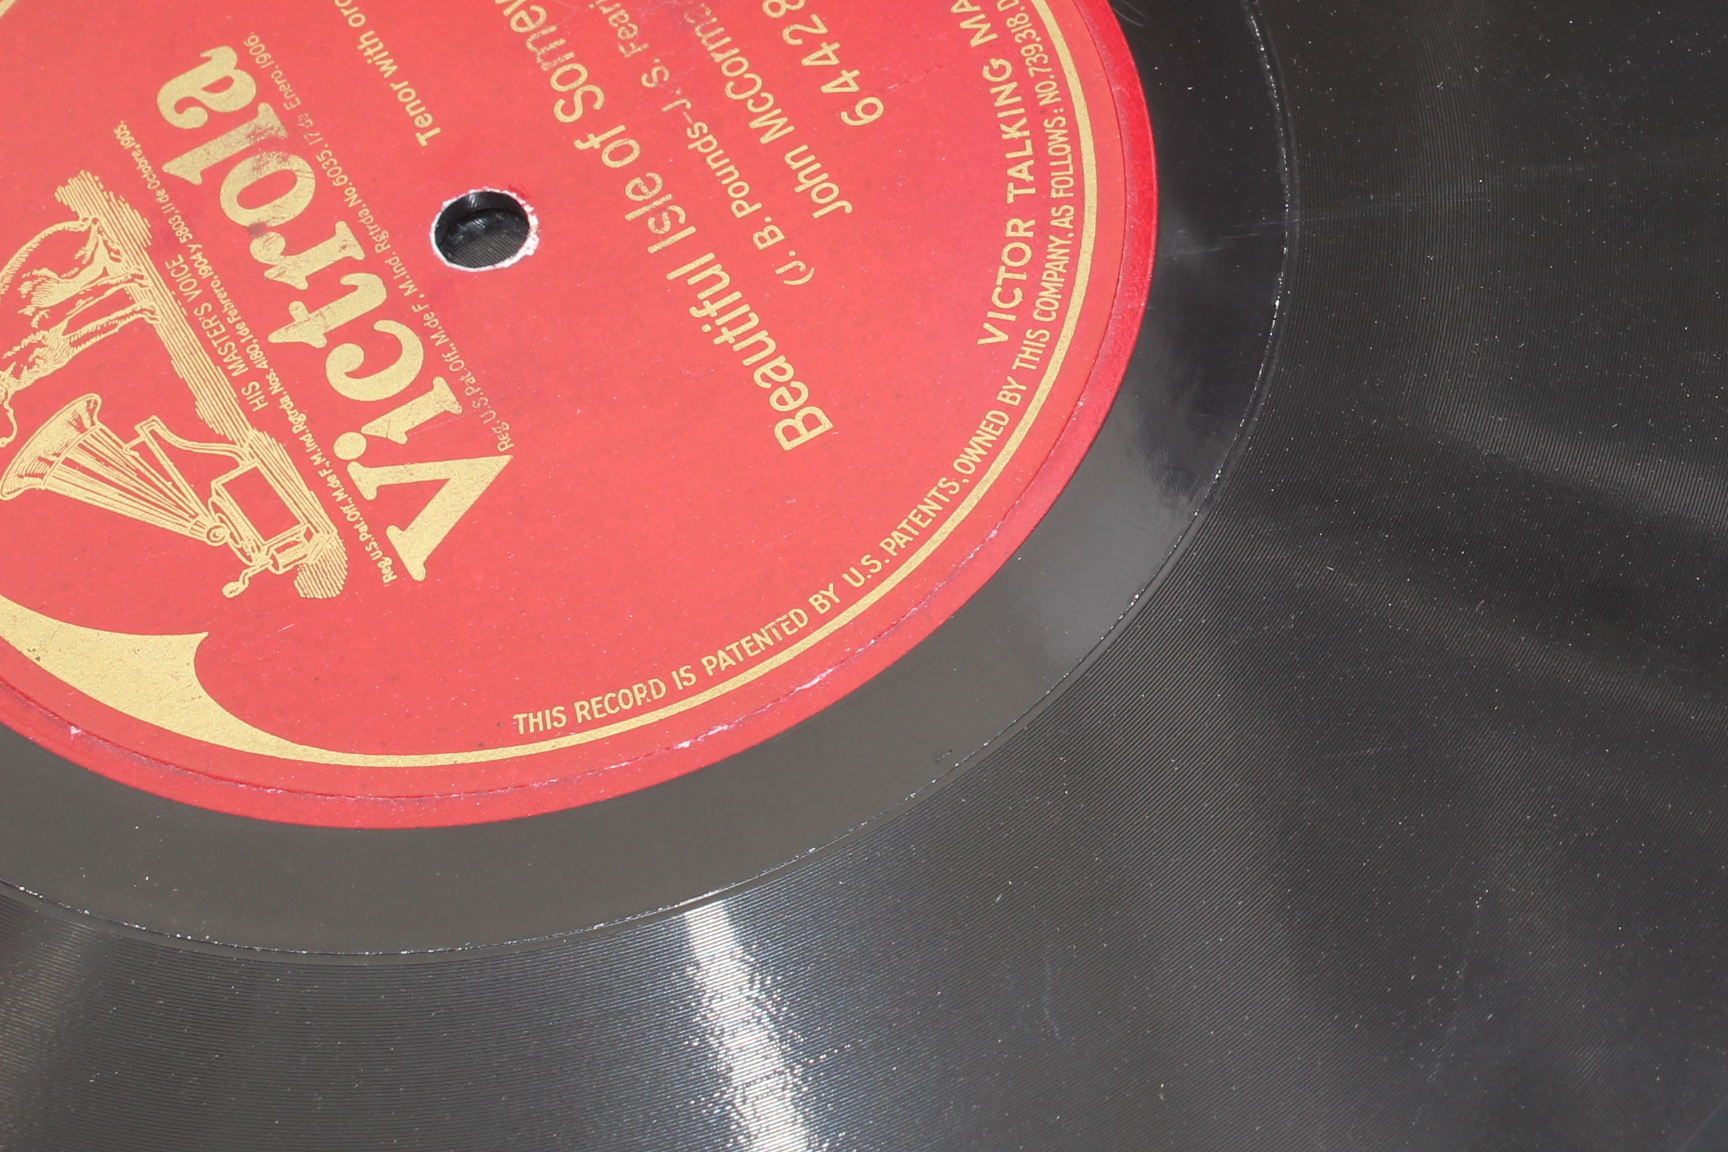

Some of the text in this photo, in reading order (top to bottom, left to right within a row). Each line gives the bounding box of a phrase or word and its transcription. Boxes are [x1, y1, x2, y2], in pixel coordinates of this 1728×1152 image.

[357, 30, 398, 78] with
[640, 58, 670, 88] S.
[389, 80, 442, 147] Tenor
[982, 58, 1036, 204] TALKING
[573, 124, 641, 168] of
[1043, 107, 1075, 198] FOLLOWS:
[783, 144, 852, 219] John
[624, 172, 697, 254] Isle
[752, 216, 785, 250] B.
[1049, 205, 1075, 229] AS
[186, 243, 203, 254] y
[774, 250, 815, 286] (J.
[977, 218, 1036, 346] VICTOR
[157, 45, 514, 582] Victrola
[165, 254, 269, 412] HIS MASTER'S VOICE
[665, 252, 834, 451] Beautiful
[1012, 328, 1050, 370] THIS
[996, 376, 1027, 406] BY
[952, 409, 1010, 475] OWNED
[808, 583, 841, 614] BY
[701, 608, 809, 677] PATENTED
[574, 678, 667, 724] RECORD
[671, 665, 697, 690] IS
[513, 706, 567, 735] THIS
